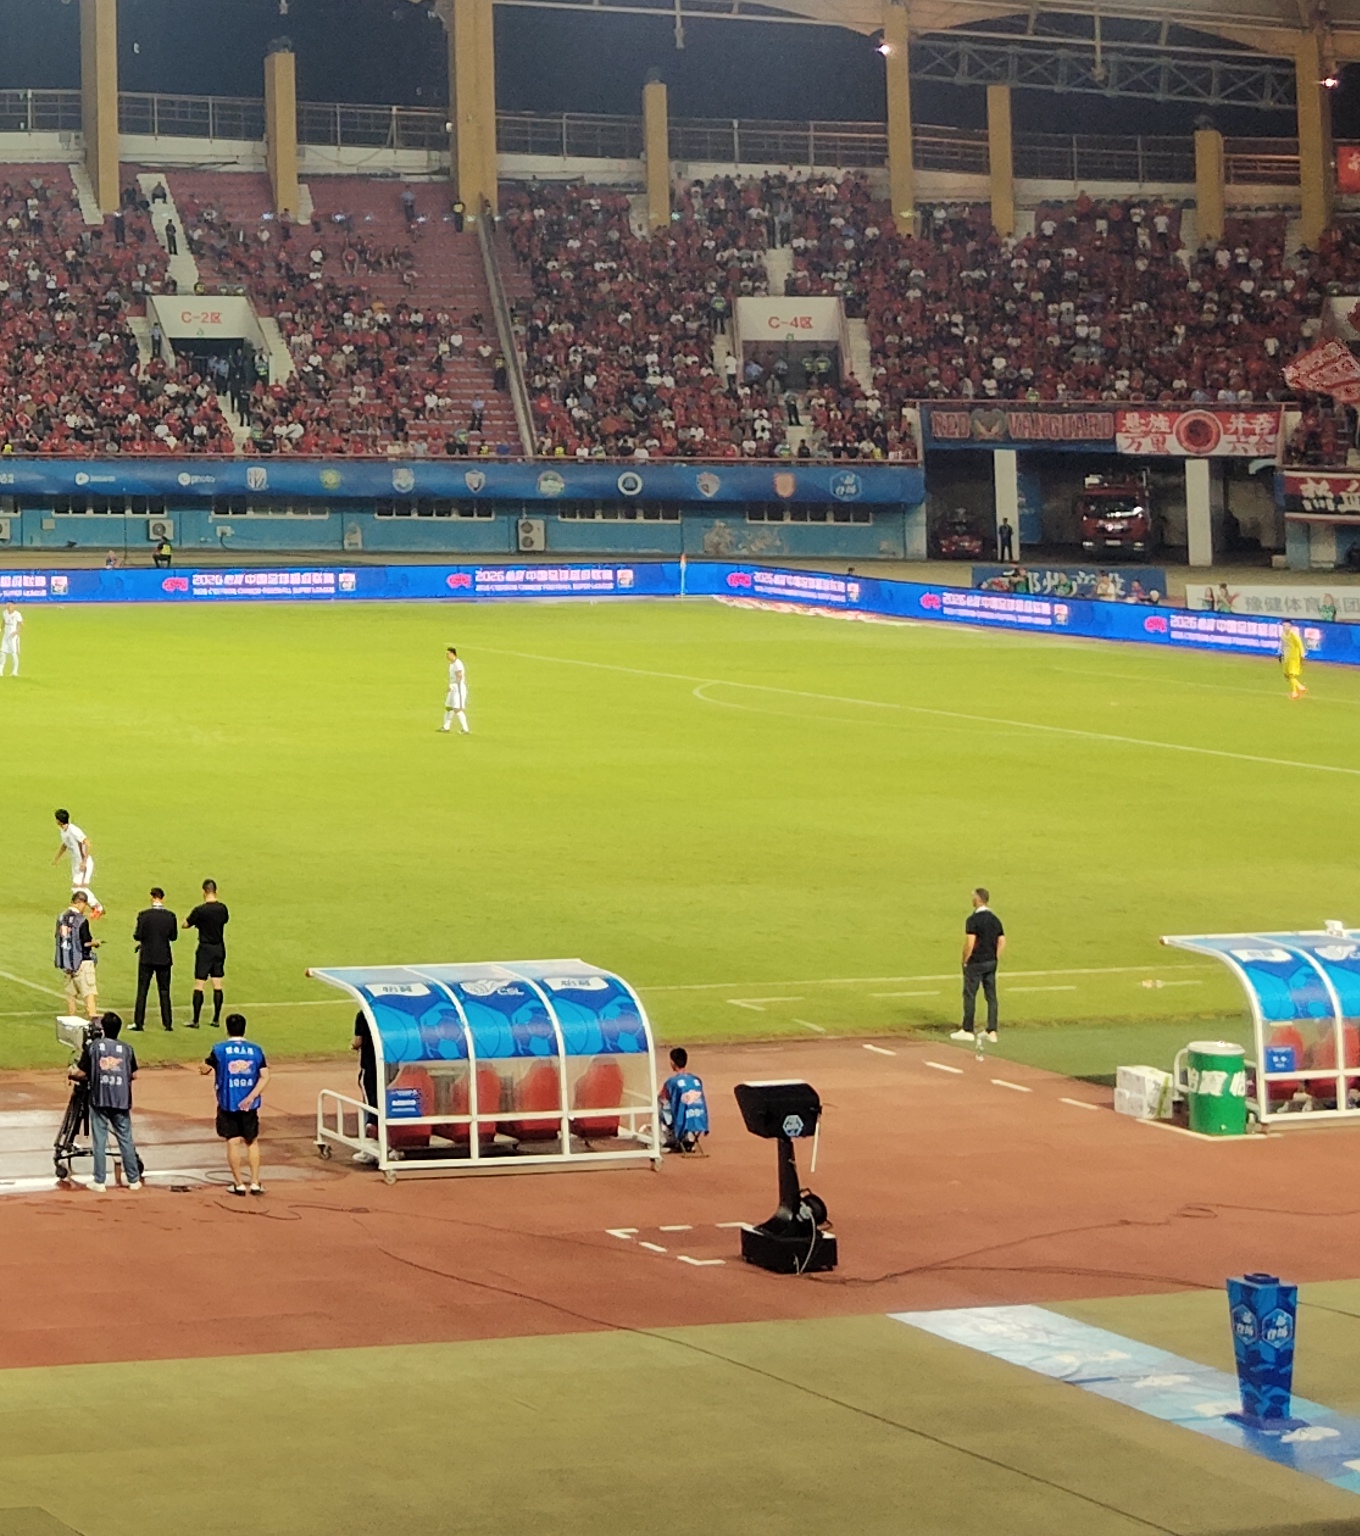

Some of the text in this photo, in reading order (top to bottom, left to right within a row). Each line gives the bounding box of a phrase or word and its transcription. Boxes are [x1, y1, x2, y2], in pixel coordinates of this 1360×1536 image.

[181, 312, 222, 324] C-2区
[768, 317, 813, 329] C-4区
[932, 412, 1115, 440] RED VANGUARD
[1125, 435, 1171, 454] 万里
[1245, 596, 1360, 614] 豫健体育团
[497, 987, 524, 995] CSL
